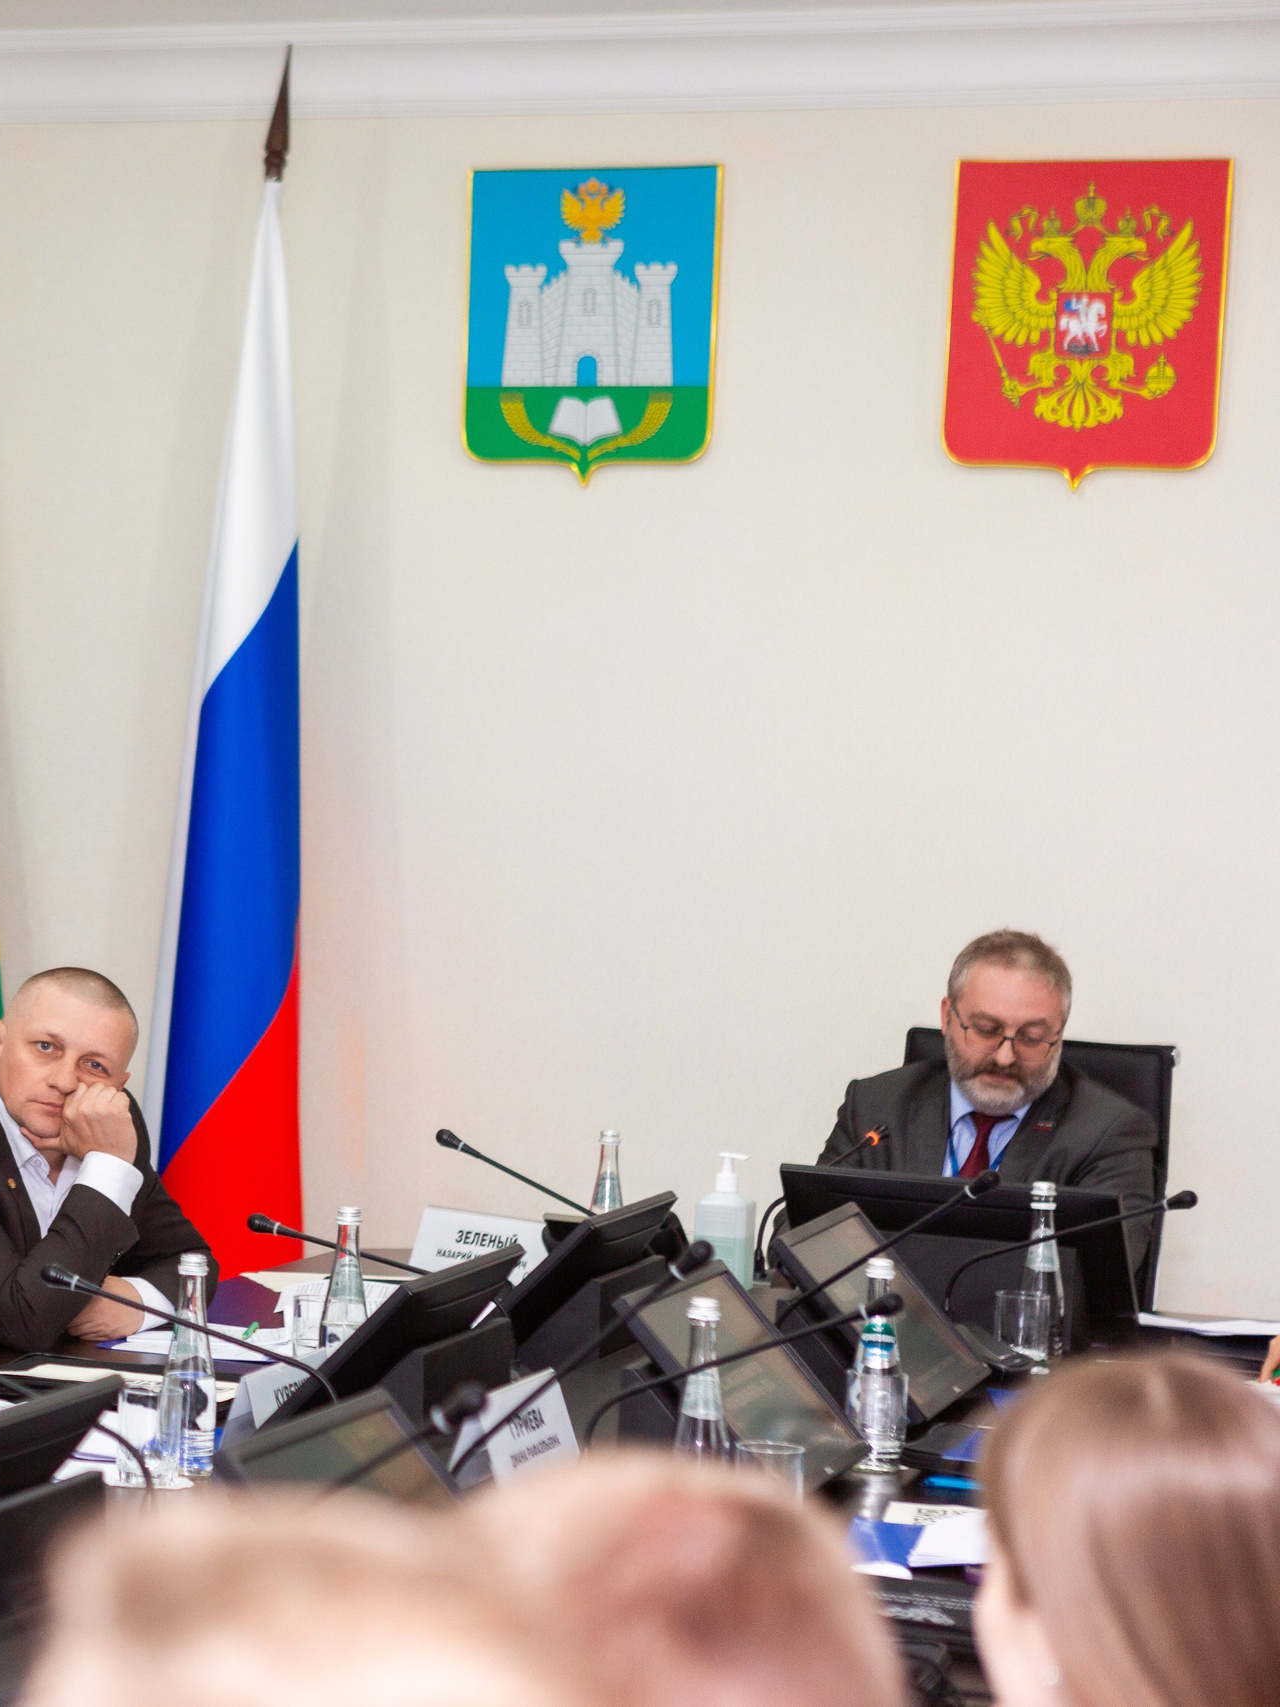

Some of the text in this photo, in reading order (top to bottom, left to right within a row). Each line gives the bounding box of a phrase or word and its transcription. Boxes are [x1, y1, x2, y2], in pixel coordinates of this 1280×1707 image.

[455, 1230, 519, 1249] ЗЕЛЕНЫЙ
[436, 1248, 473, 1261] НАЗАРИЙ
[274, 1378, 309, 1408] КУРЕ
